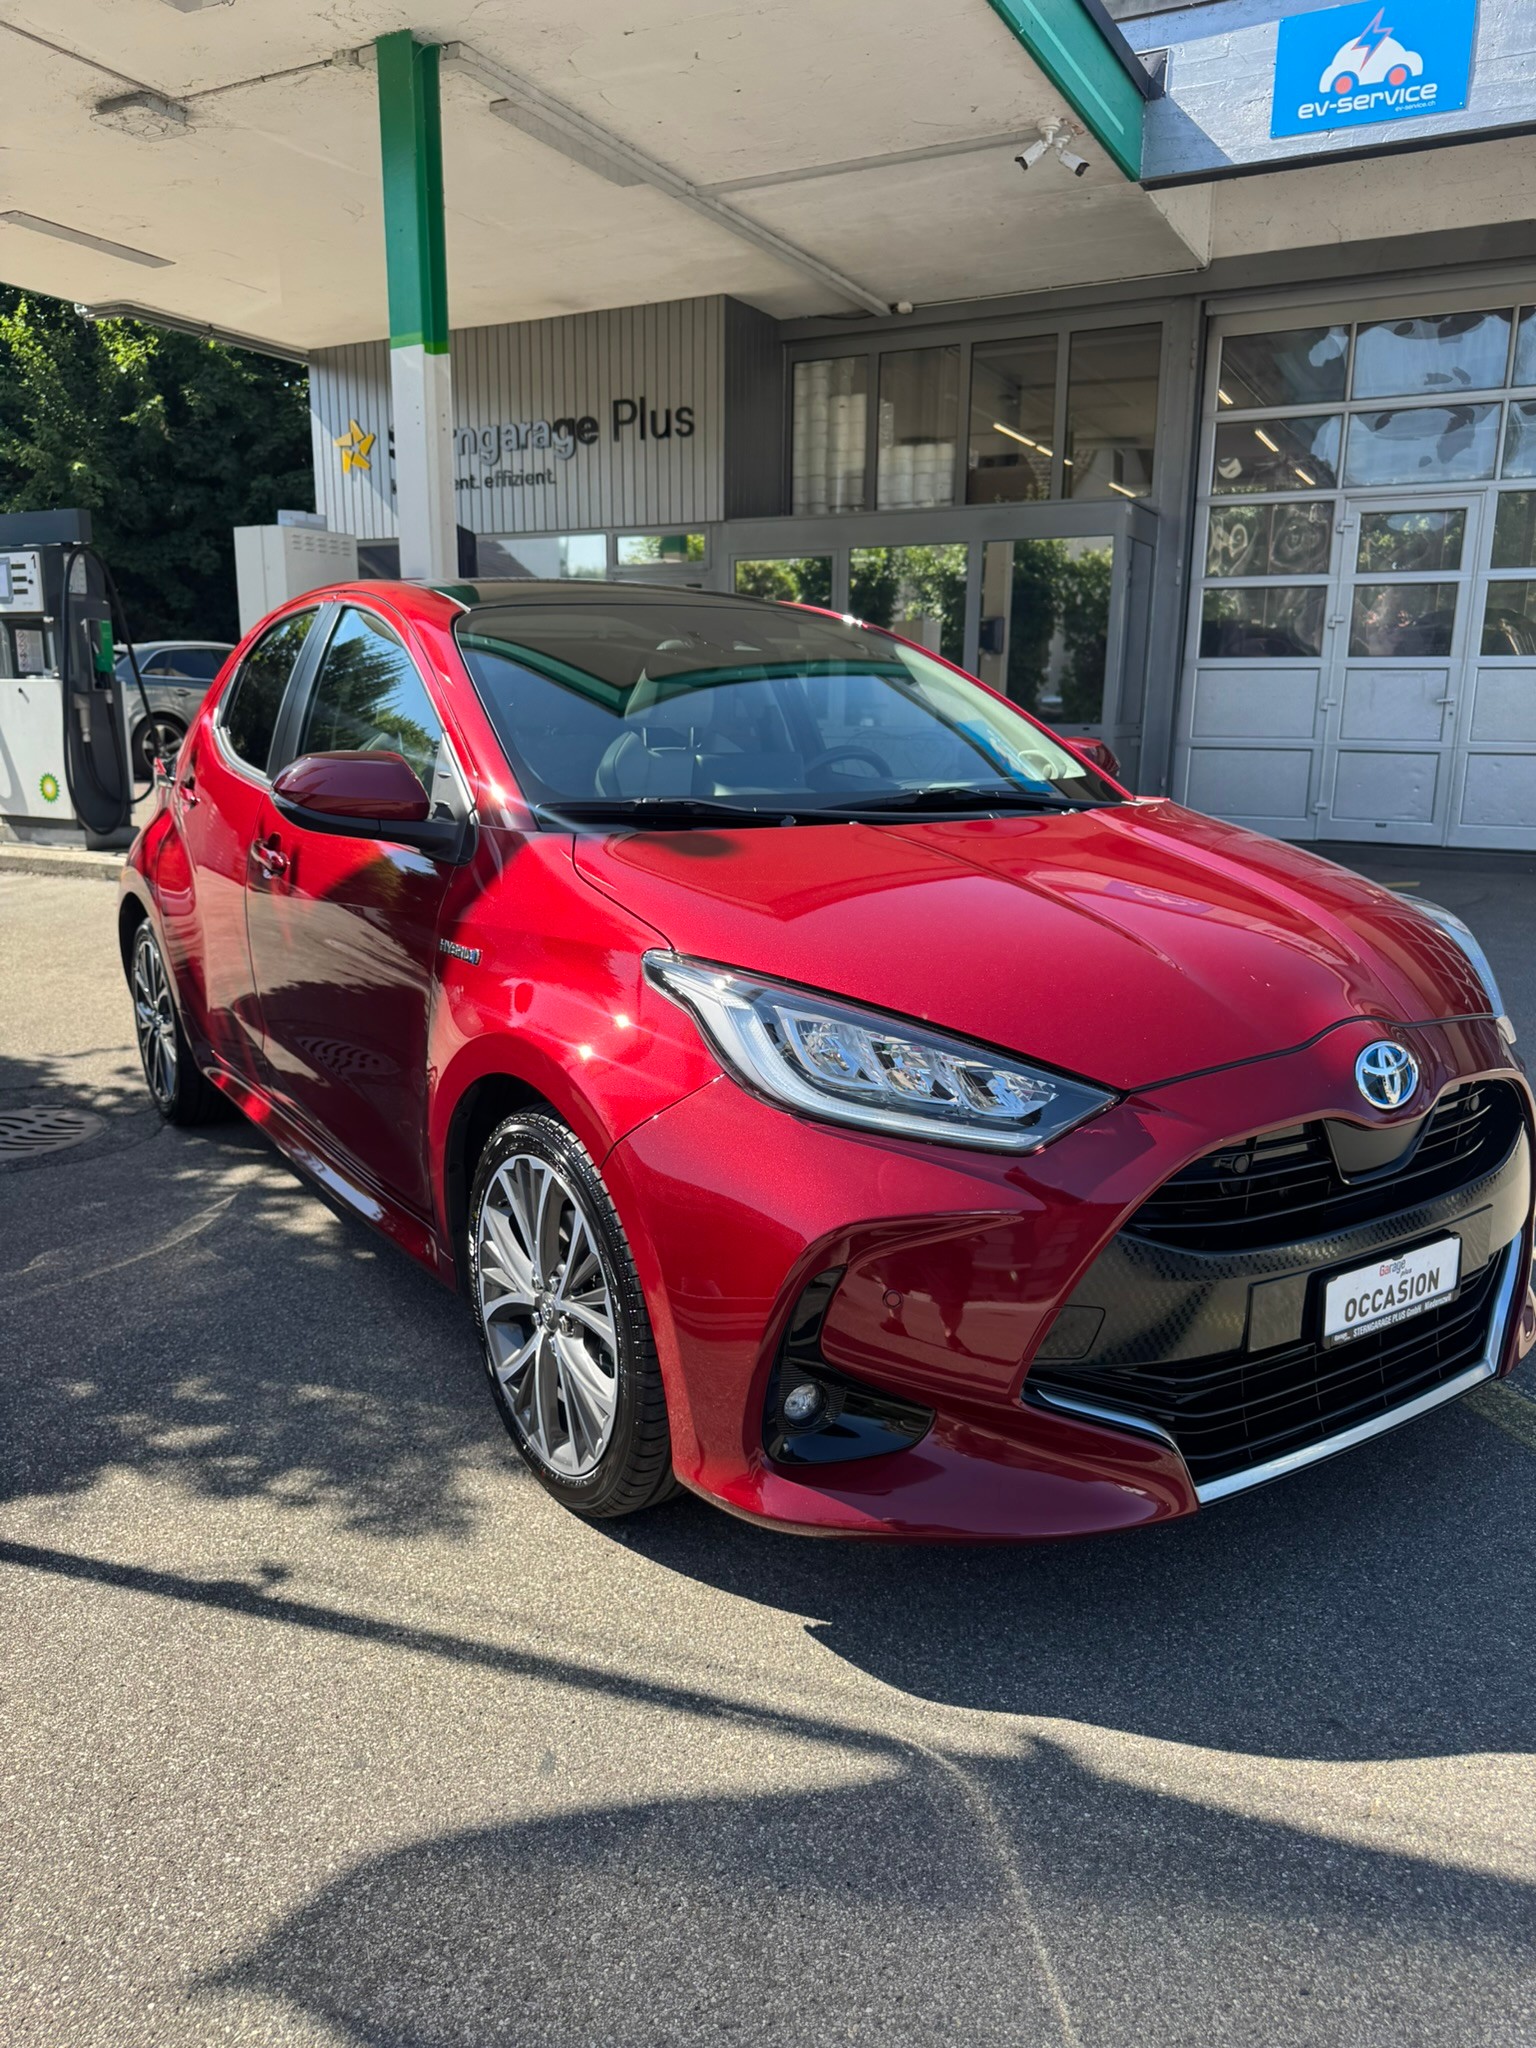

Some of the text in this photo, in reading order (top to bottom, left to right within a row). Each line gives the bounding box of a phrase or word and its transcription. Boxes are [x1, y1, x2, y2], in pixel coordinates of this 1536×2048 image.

[1297, 83, 1438, 119] ev-service
[1394, 99, 1437, 113] ev-service.ch
[612, 396, 695, 442] Plus
[1379, 1259, 1406, 1277] Garage
[1344, 1267, 1440, 1323] OCCASION
